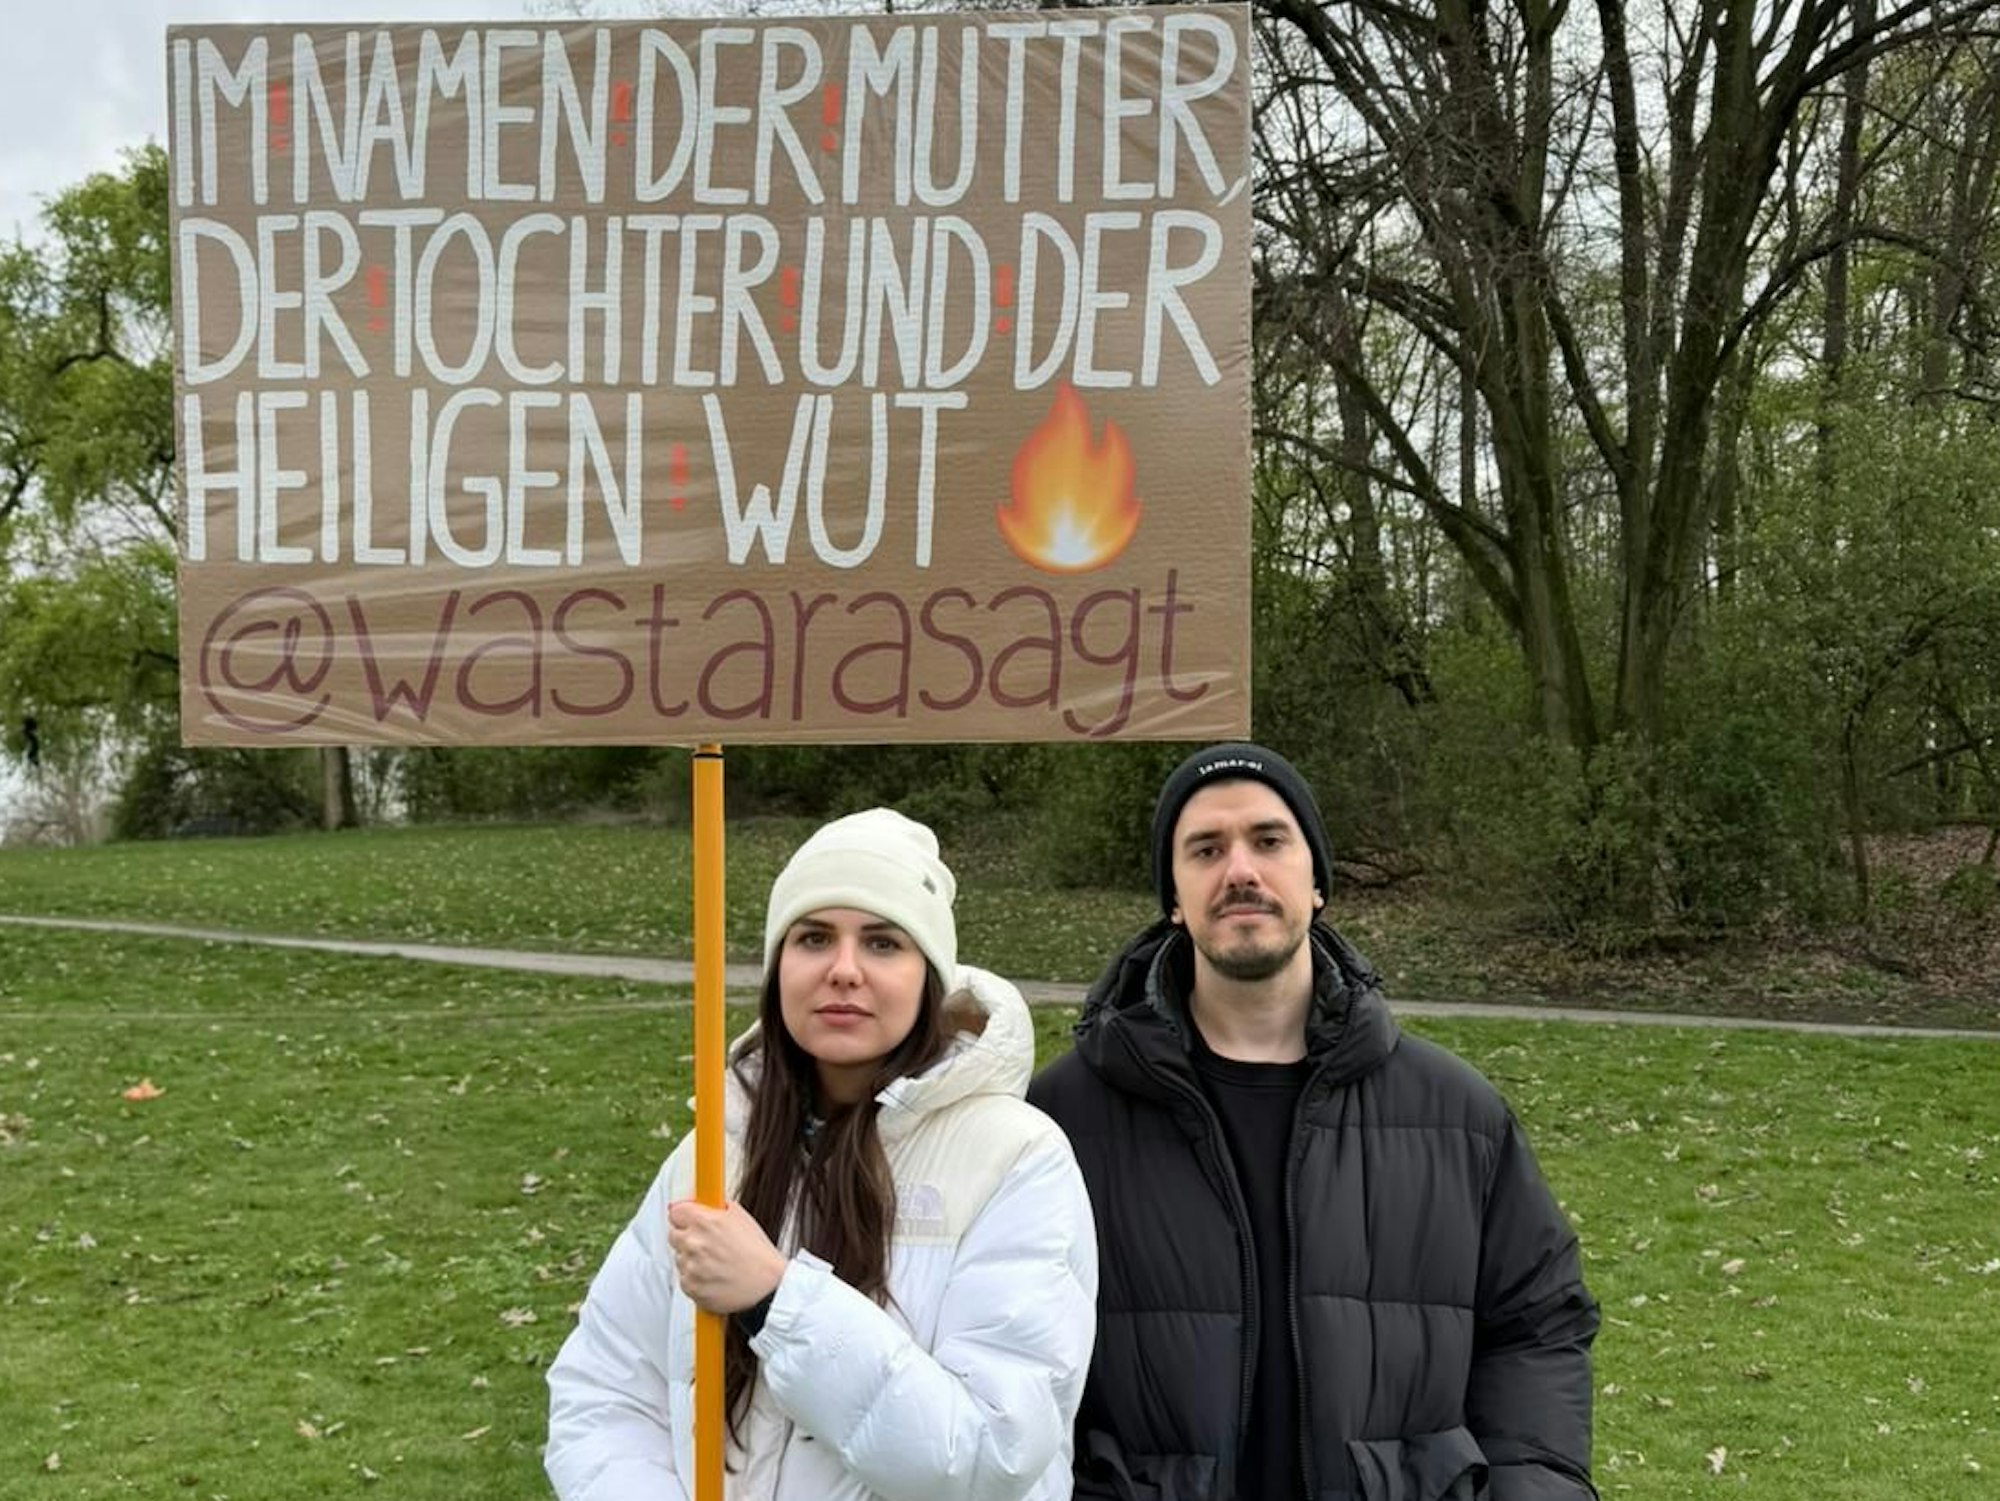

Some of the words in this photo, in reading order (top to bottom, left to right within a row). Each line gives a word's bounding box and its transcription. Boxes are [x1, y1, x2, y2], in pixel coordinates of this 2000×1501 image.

[842, 14, 1247, 206] MUTTER,
[1014, 210, 1223, 391] DER
[702, 392, 969, 569] WUT
